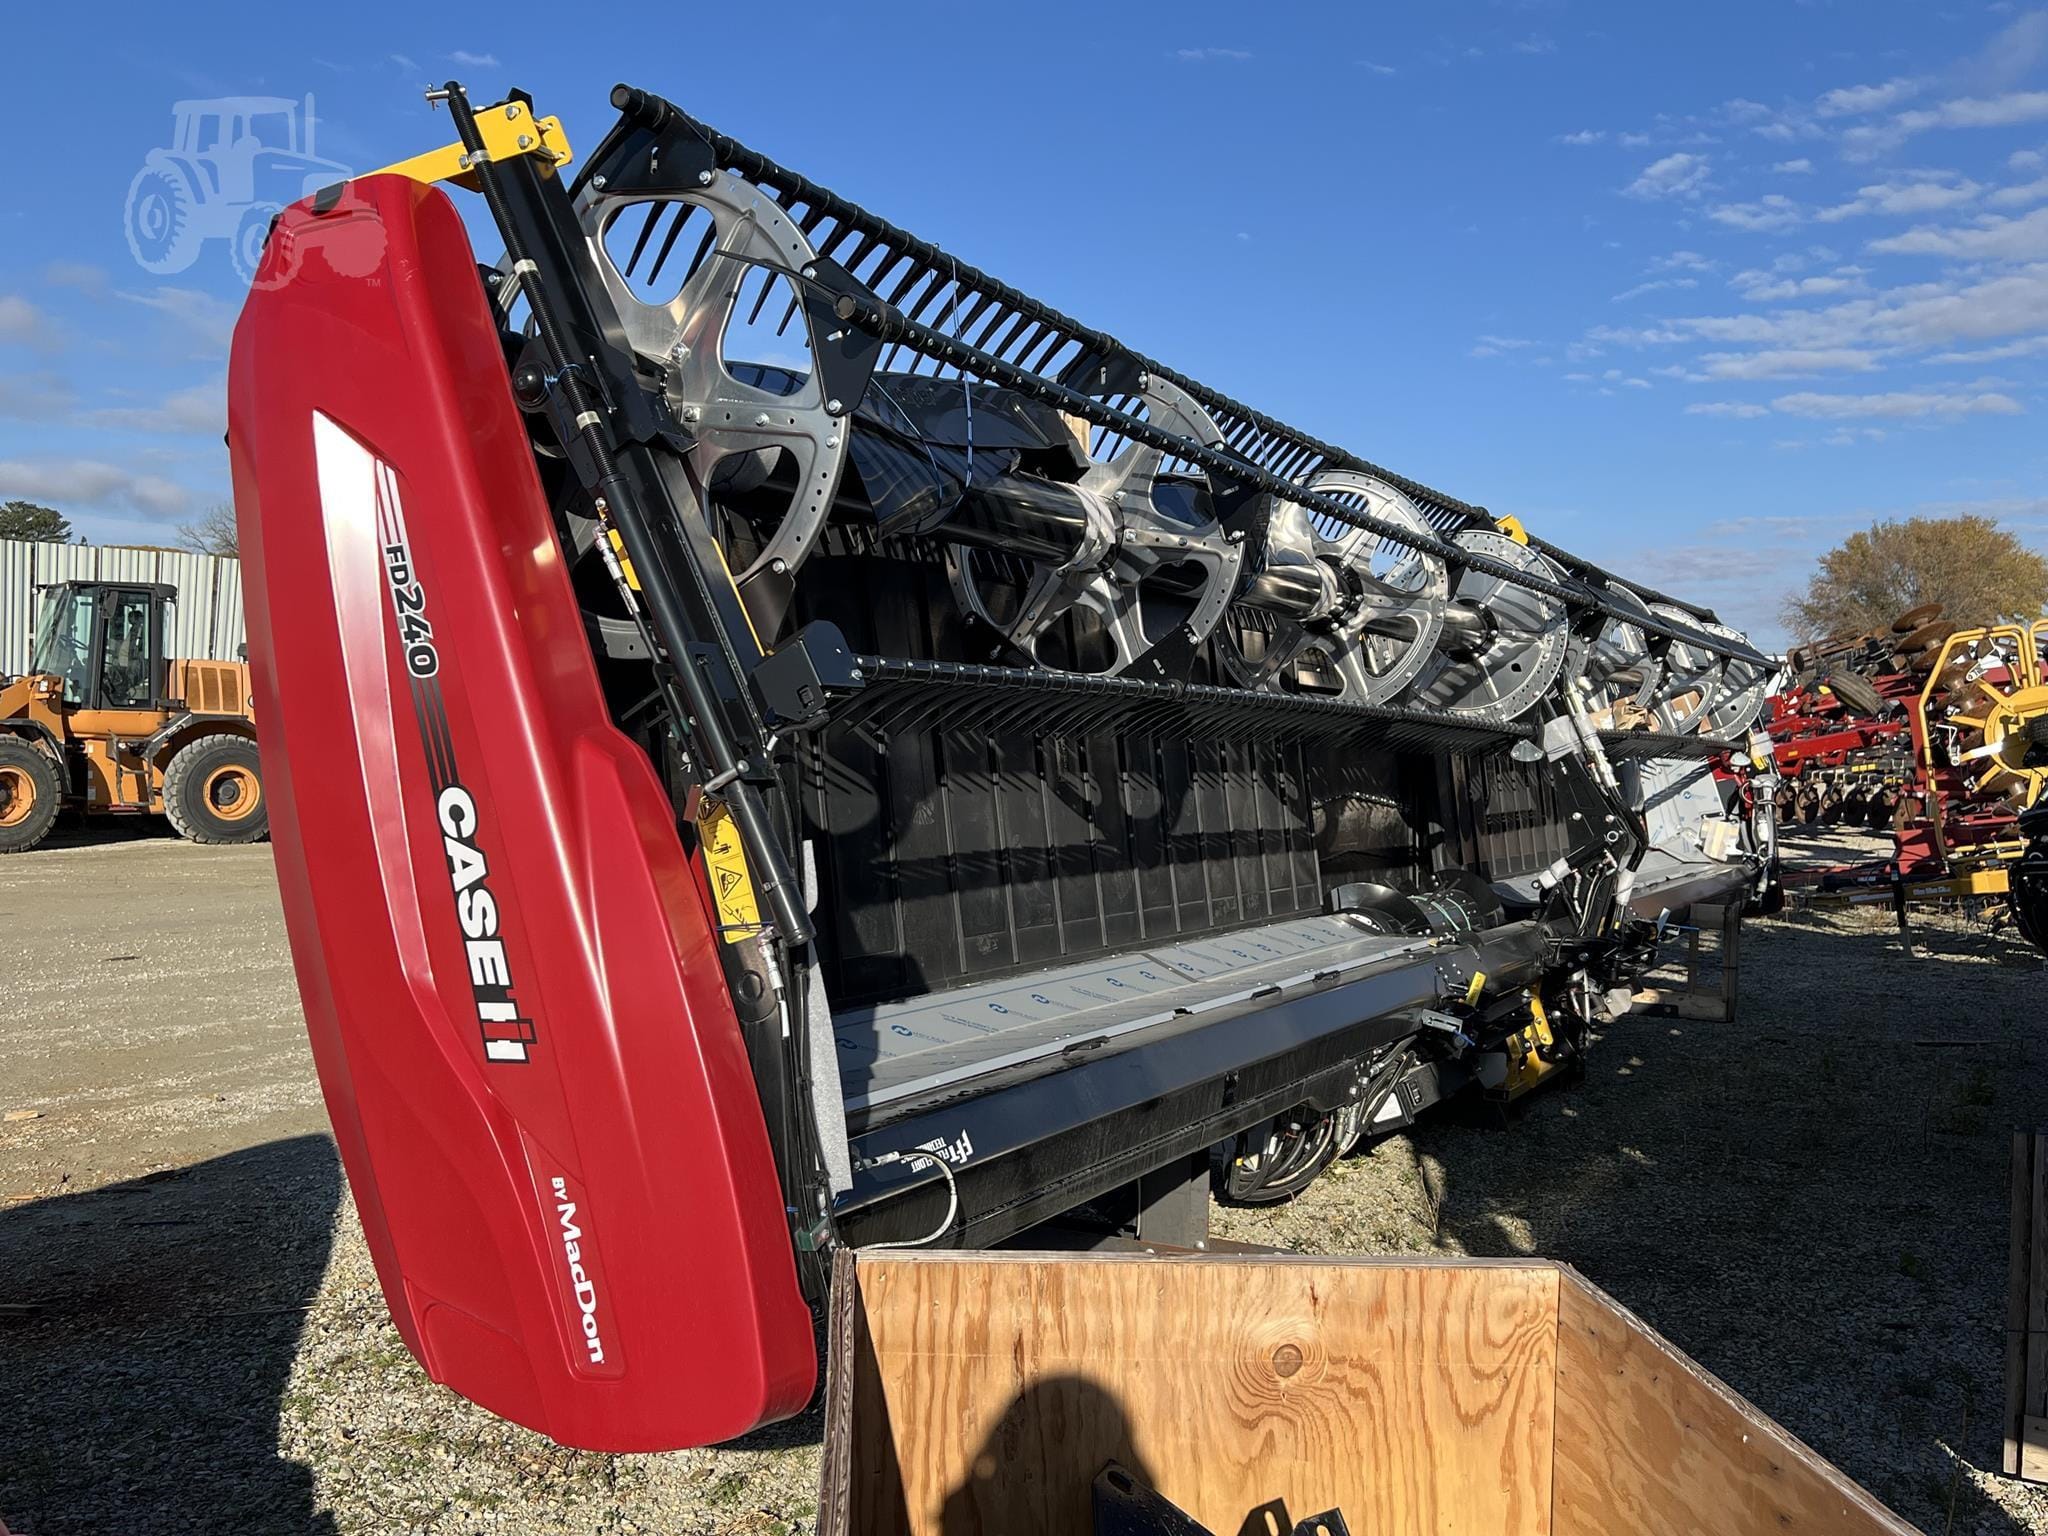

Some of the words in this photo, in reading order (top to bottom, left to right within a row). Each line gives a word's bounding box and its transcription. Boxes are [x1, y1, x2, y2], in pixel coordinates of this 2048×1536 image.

[385, 545, 439, 677] FD240
[438, 786, 511, 986] CASE
[551, 1177, 568, 1201] BY
[948, 1129, 973, 1164] FFT
[557, 1202, 605, 1364] MacDon
